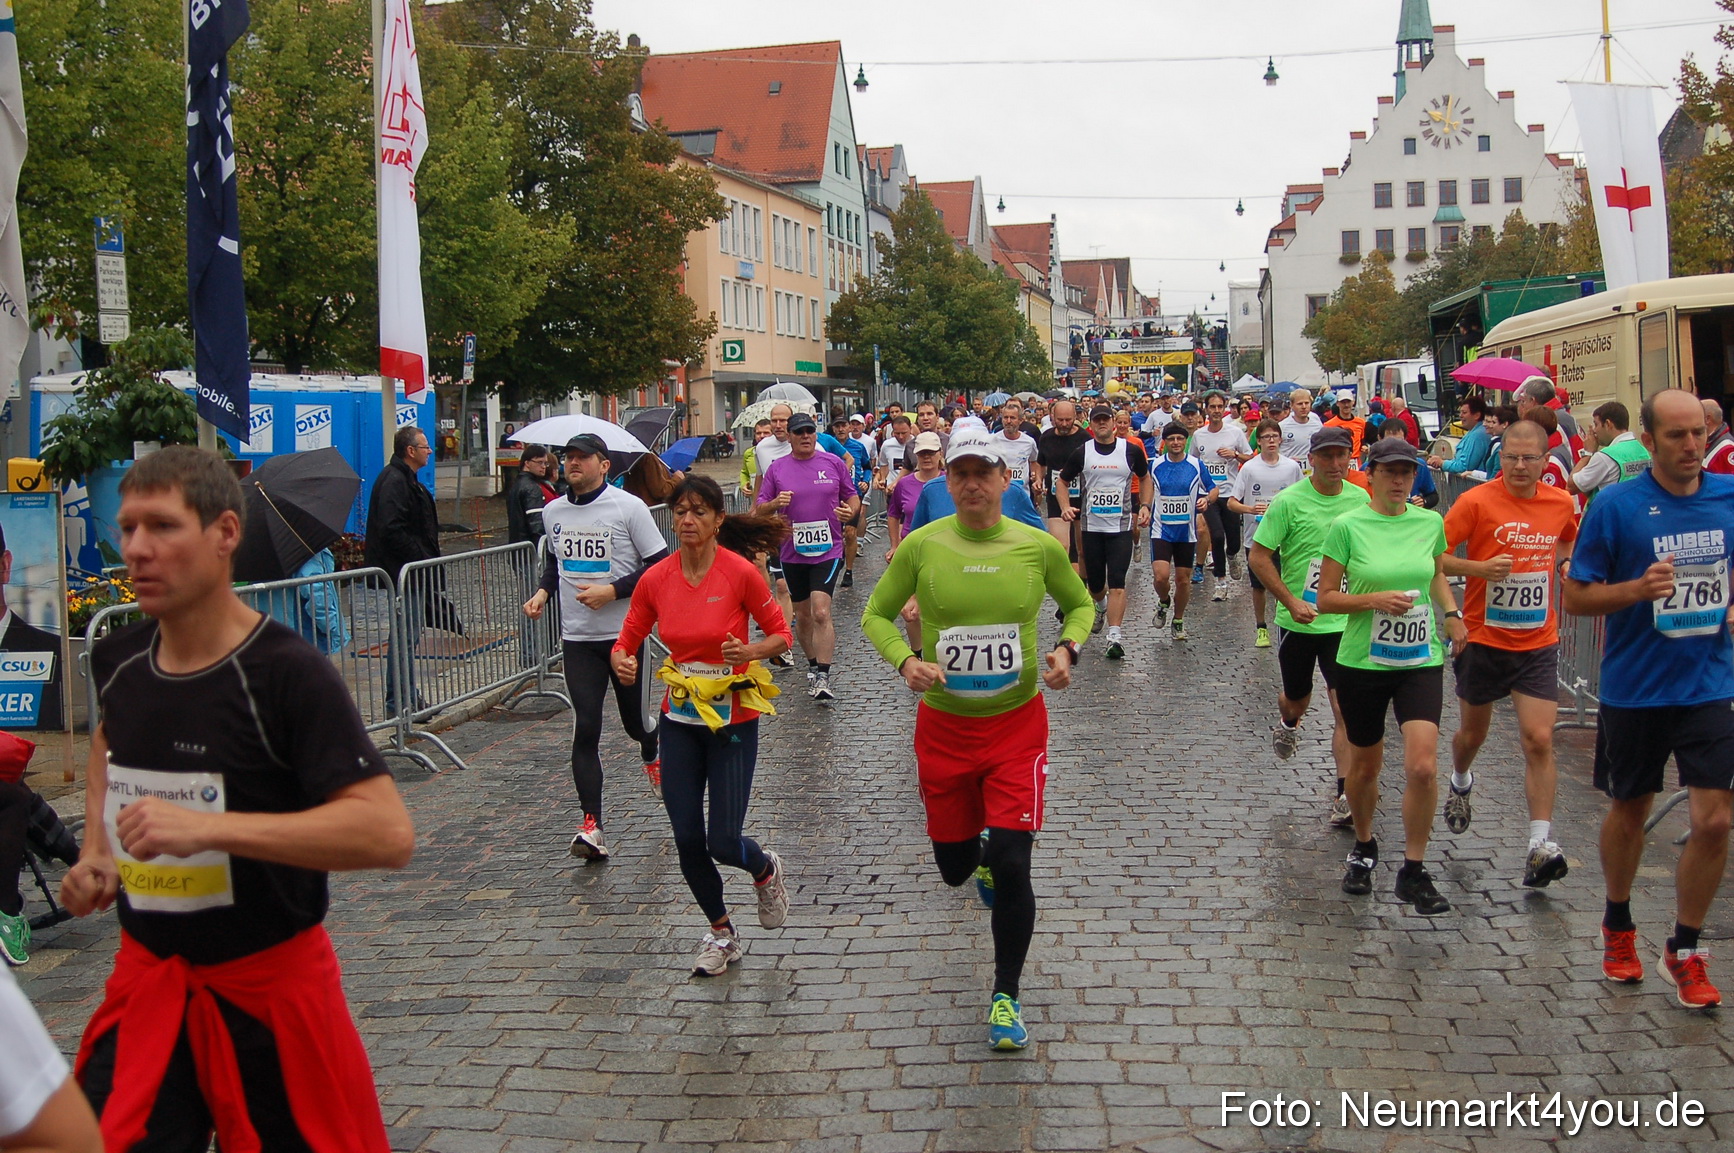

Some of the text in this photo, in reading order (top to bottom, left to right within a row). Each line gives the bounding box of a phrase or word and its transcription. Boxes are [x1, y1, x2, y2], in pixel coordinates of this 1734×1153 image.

[726, 343, 742, 359] D
[1562, 333, 1612, 362] Bayerisches
[1132, 355, 1163, 364] START
[1561, 364, 1585, 383] Rotes
[1568, 391, 1584, 406] reuz
[818, 470, 828, 479] K
[1092, 494, 1120, 506] 2692
[1162, 502, 1188, 514] 3080
[797, 529, 829, 545] 2045
[1506, 531, 1557, 545] Fischer
[1652, 529, 1725, 553] HUBER
[564, 538, 606, 559] 3165
[1674, 546, 1723, 558] ECHNOLOGY
[962, 564, 1001, 573] saller
[1510, 576, 1540, 585] Neumarkt
[1492, 586, 1544, 608] 2789
[1663, 579, 1723, 611] 2768
[1498, 611, 1535, 621] Christian
[1672, 612, 1717, 627] Willibald
[966, 632, 1005, 641] Neumarkt
[1378, 618, 1427, 644] 2906
[945, 643, 1014, 672] 2719
[1381, 646, 1420, 657] Rosalinde
[1, 661, 31, 672] CSU
[108, 781, 133, 796] ARTL
[121, 864, 194, 892] Reiner
